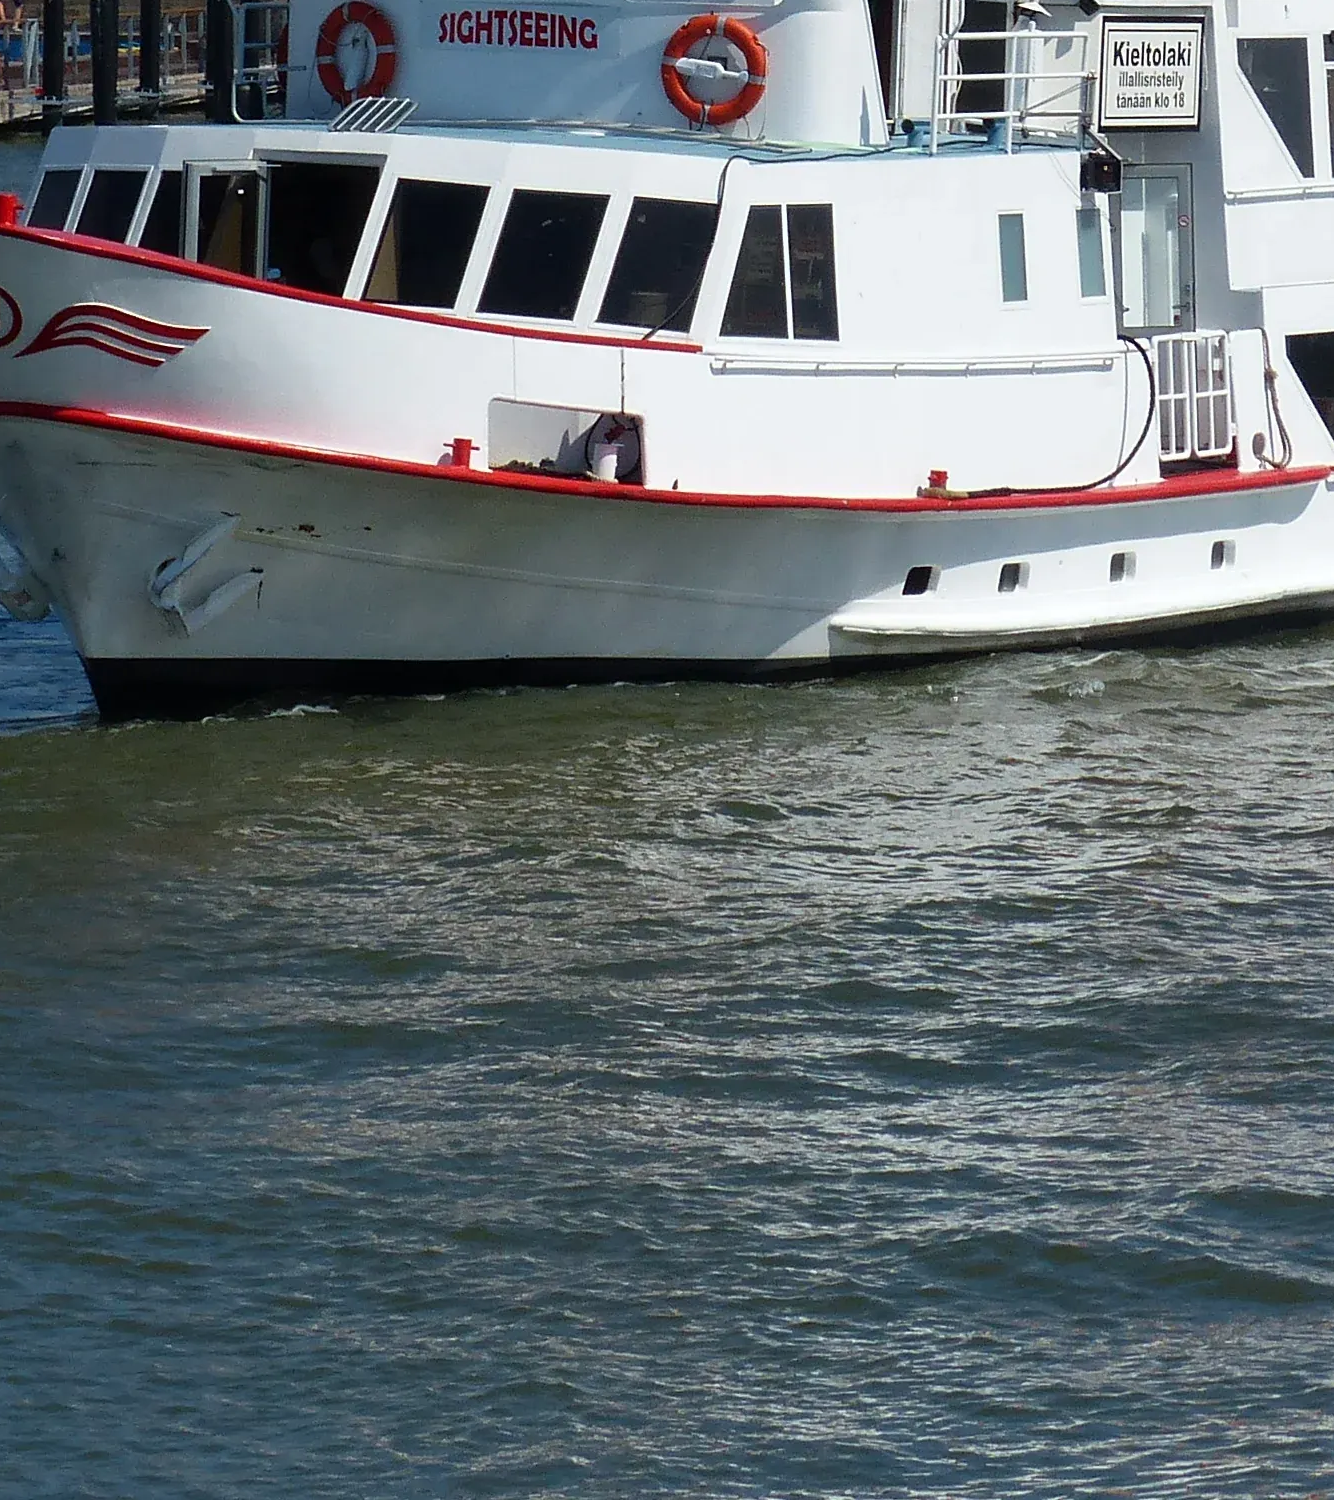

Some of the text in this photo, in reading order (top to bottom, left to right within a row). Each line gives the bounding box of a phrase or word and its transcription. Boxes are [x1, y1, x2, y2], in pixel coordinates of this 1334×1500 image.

[438, 9, 599, 50] SIGHTSEEING
[1112, 40, 1193, 67] Kieltolaki
[1118, 71, 1185, 91] illallisristeily
[1116, 91, 1186, 109] tänään klo 18
